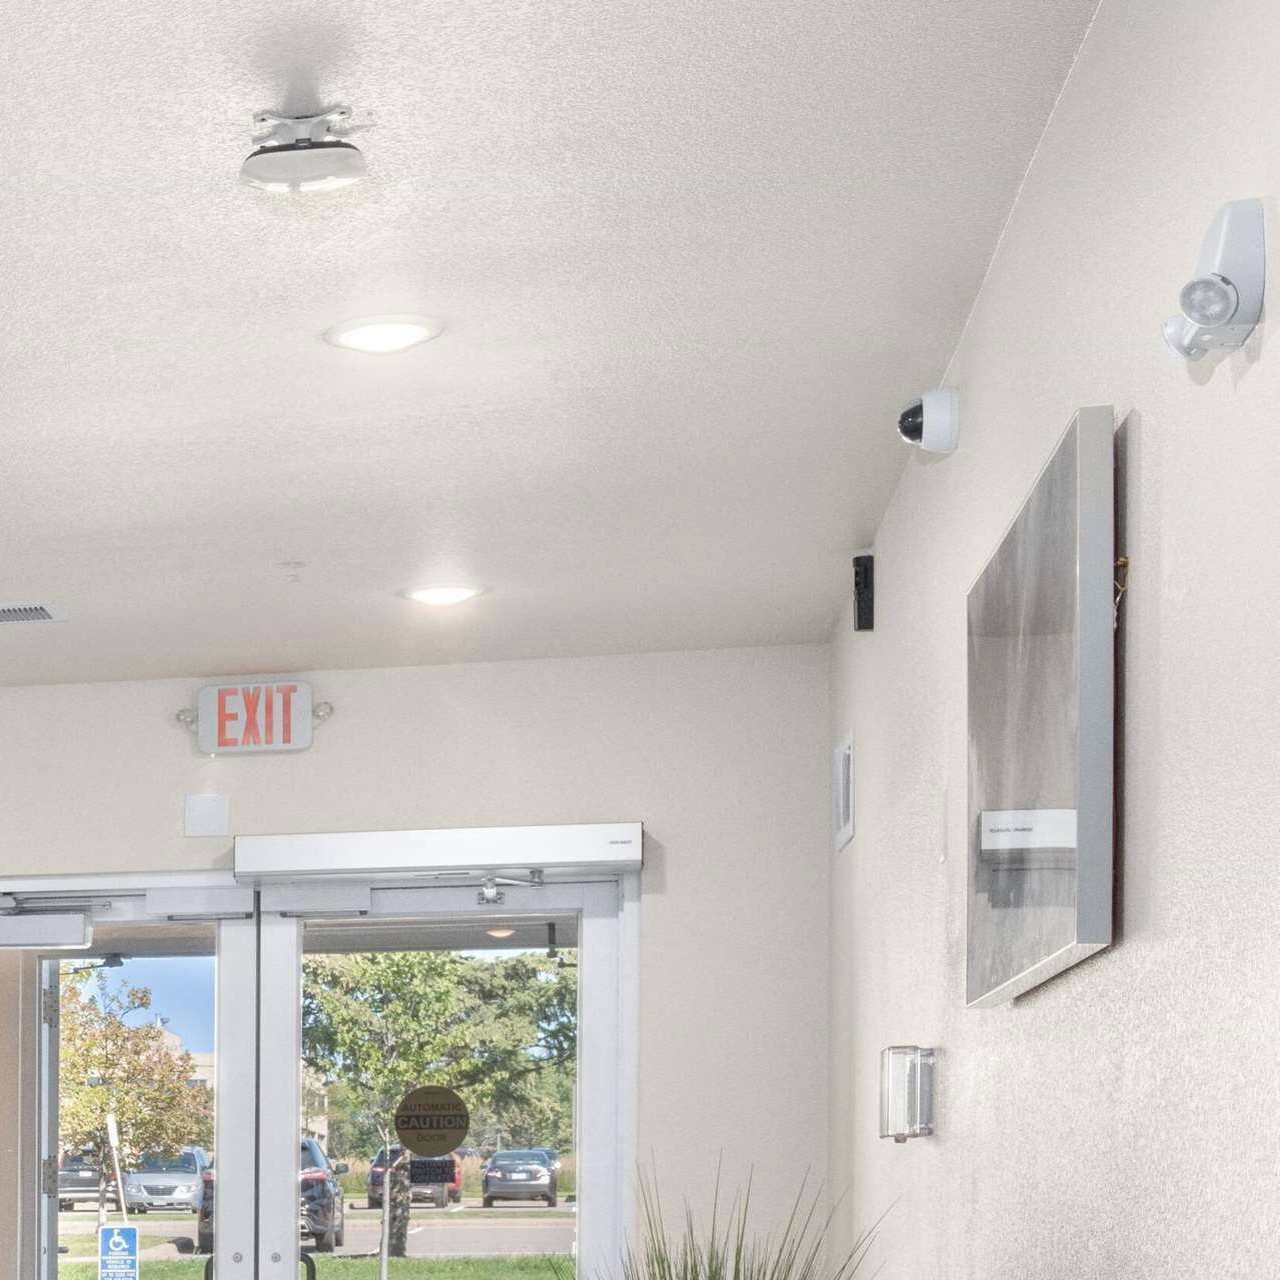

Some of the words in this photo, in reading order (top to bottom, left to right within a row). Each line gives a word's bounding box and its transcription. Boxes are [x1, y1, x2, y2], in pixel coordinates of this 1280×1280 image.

[217, 684, 297, 747] EXIT
[401, 1103, 462, 1112] AUTOMATIC
[398, 1116, 467, 1129] CAUTION
[417, 1134, 446, 1142] DOOR
